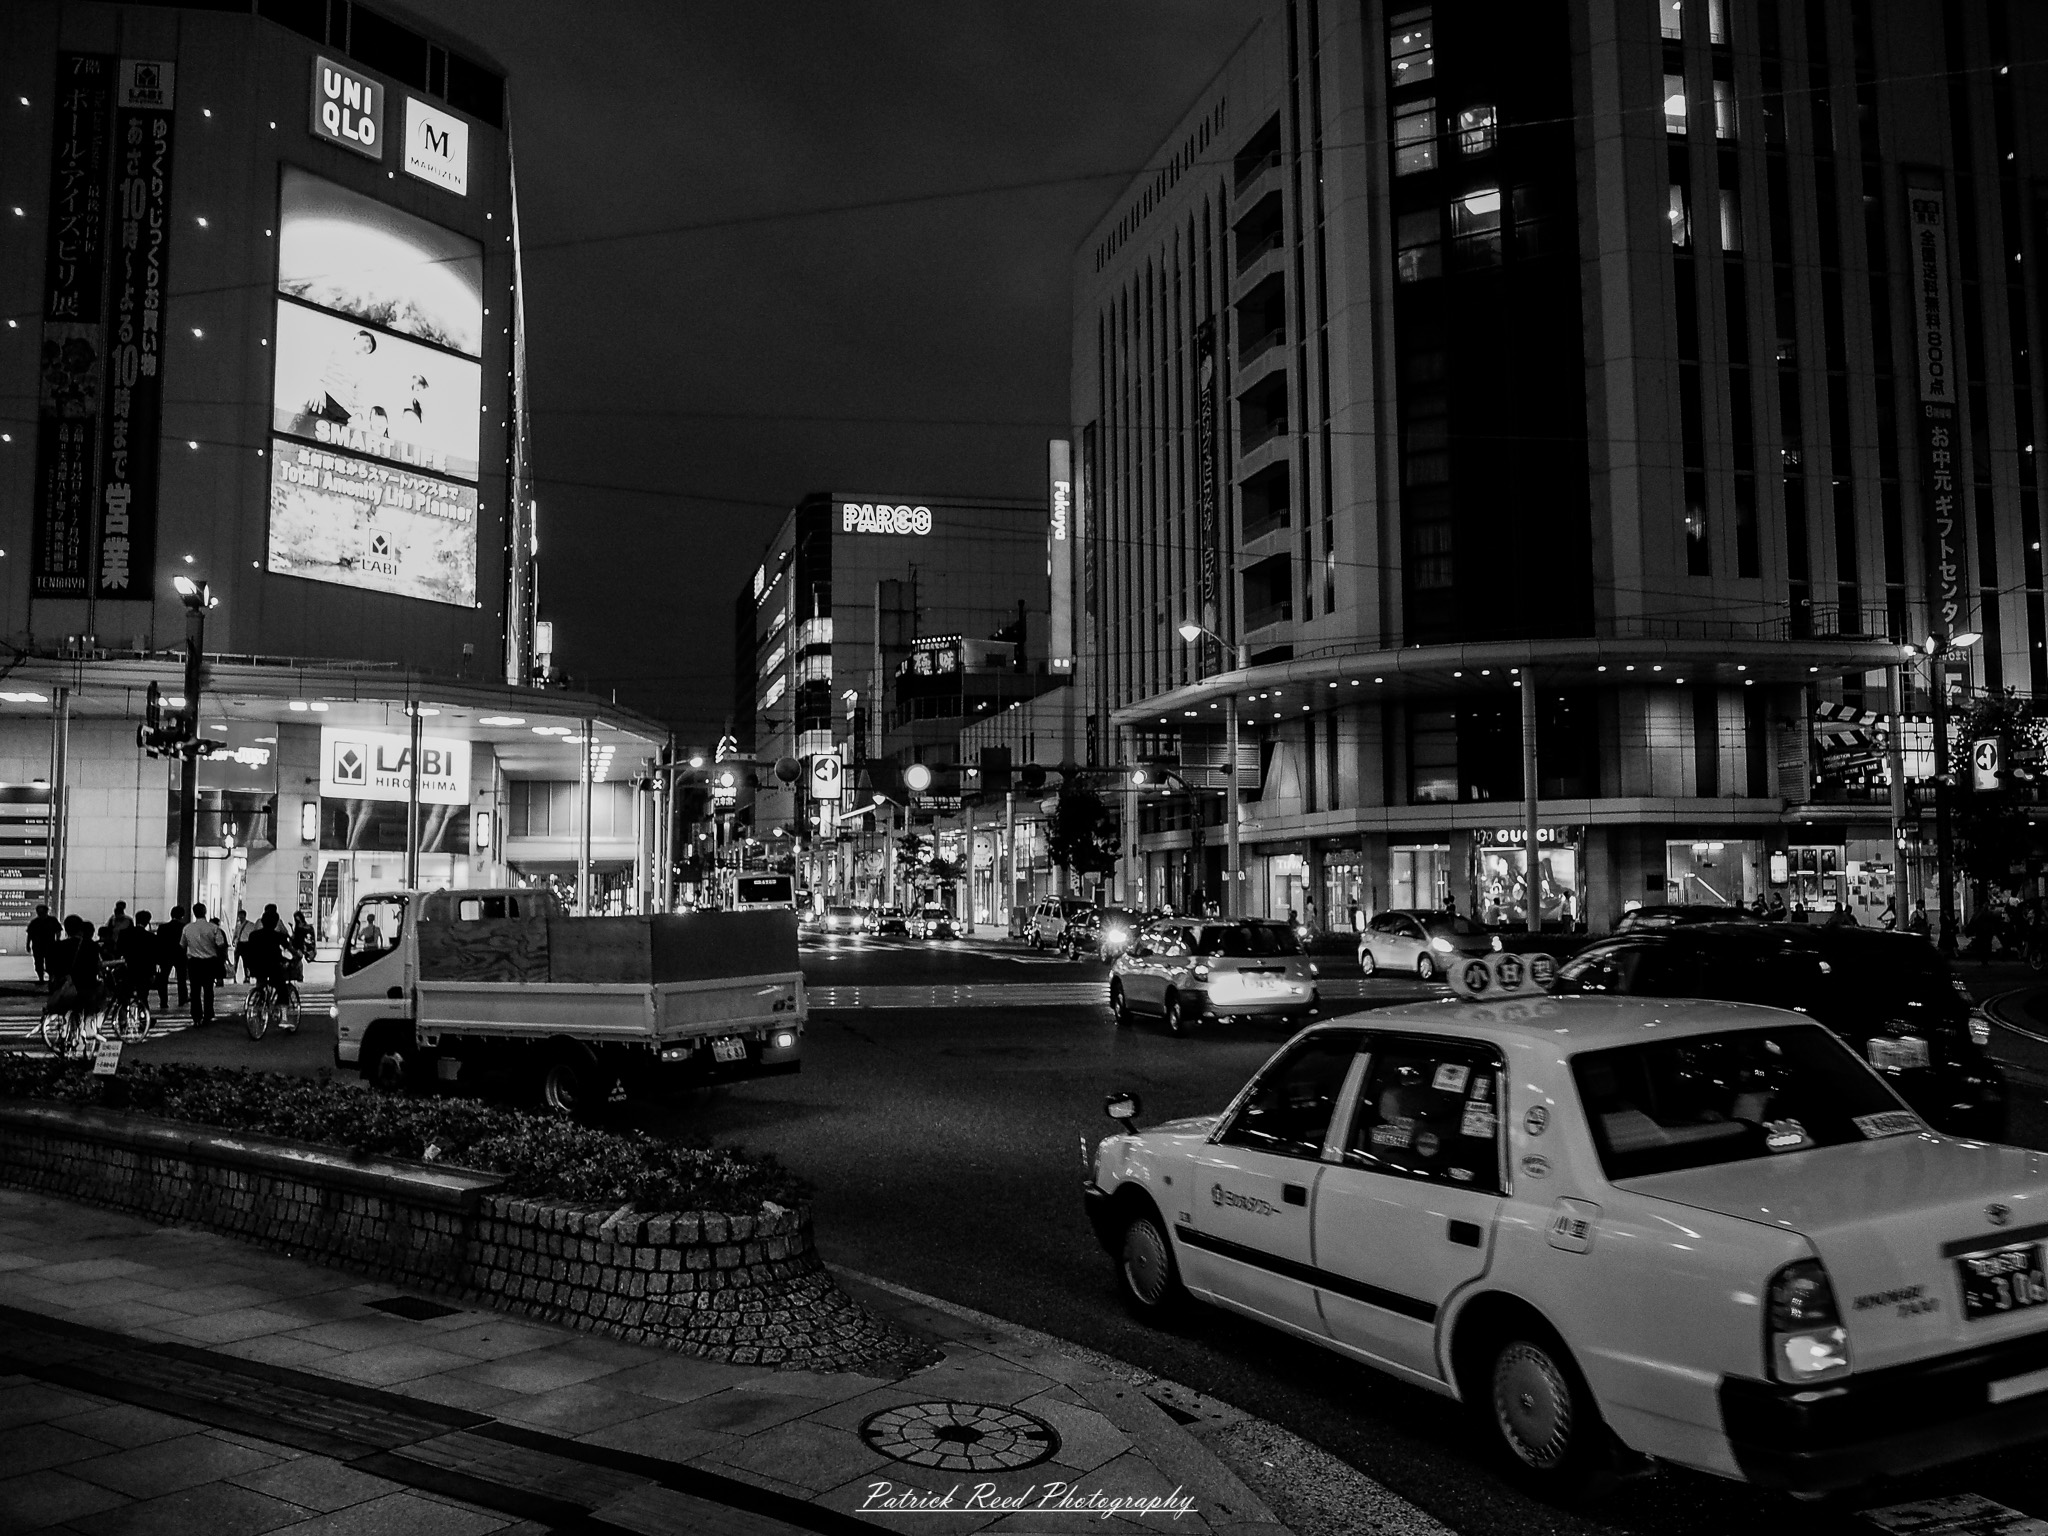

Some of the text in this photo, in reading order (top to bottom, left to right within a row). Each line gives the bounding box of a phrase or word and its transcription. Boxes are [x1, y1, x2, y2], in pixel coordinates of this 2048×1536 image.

[324, 68, 372, 115] UNI
[322, 101, 376, 145] QLO
[424, 123, 449, 158] M
[314, 419, 395, 458] SMART
[280, 460, 320, 488] Total
[415, 493, 473, 523] Planner
[298, 449, 459, 501] からスマートハウスまで
[843, 503, 933, 535] PARCO
[1050, 480, 1070, 541] Fukuya
[1931, 426, 1960, 646] お中元ギフトセンター
[36, 576, 85, 589] TENMAYA
[361, 558, 398, 576] LABI
[376, 744, 452, 777] LABI
[376, 777, 457, 792] HIROHIMA
